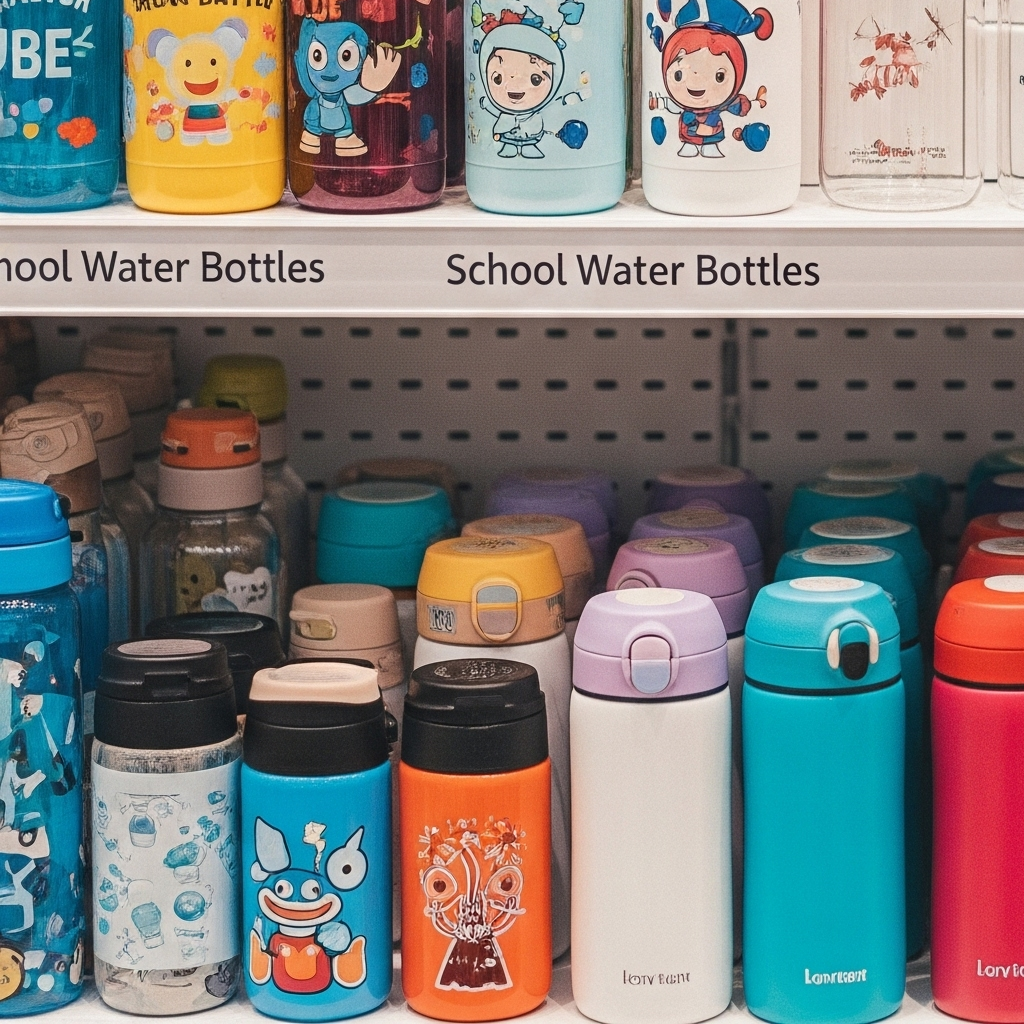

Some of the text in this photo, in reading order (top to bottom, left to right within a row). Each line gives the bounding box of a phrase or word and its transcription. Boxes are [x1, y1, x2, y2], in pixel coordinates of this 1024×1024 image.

[80, 250, 190, 283] Water
[201, 249, 325, 284] Bottles
[446, 251, 820, 287] School Water Bottles
